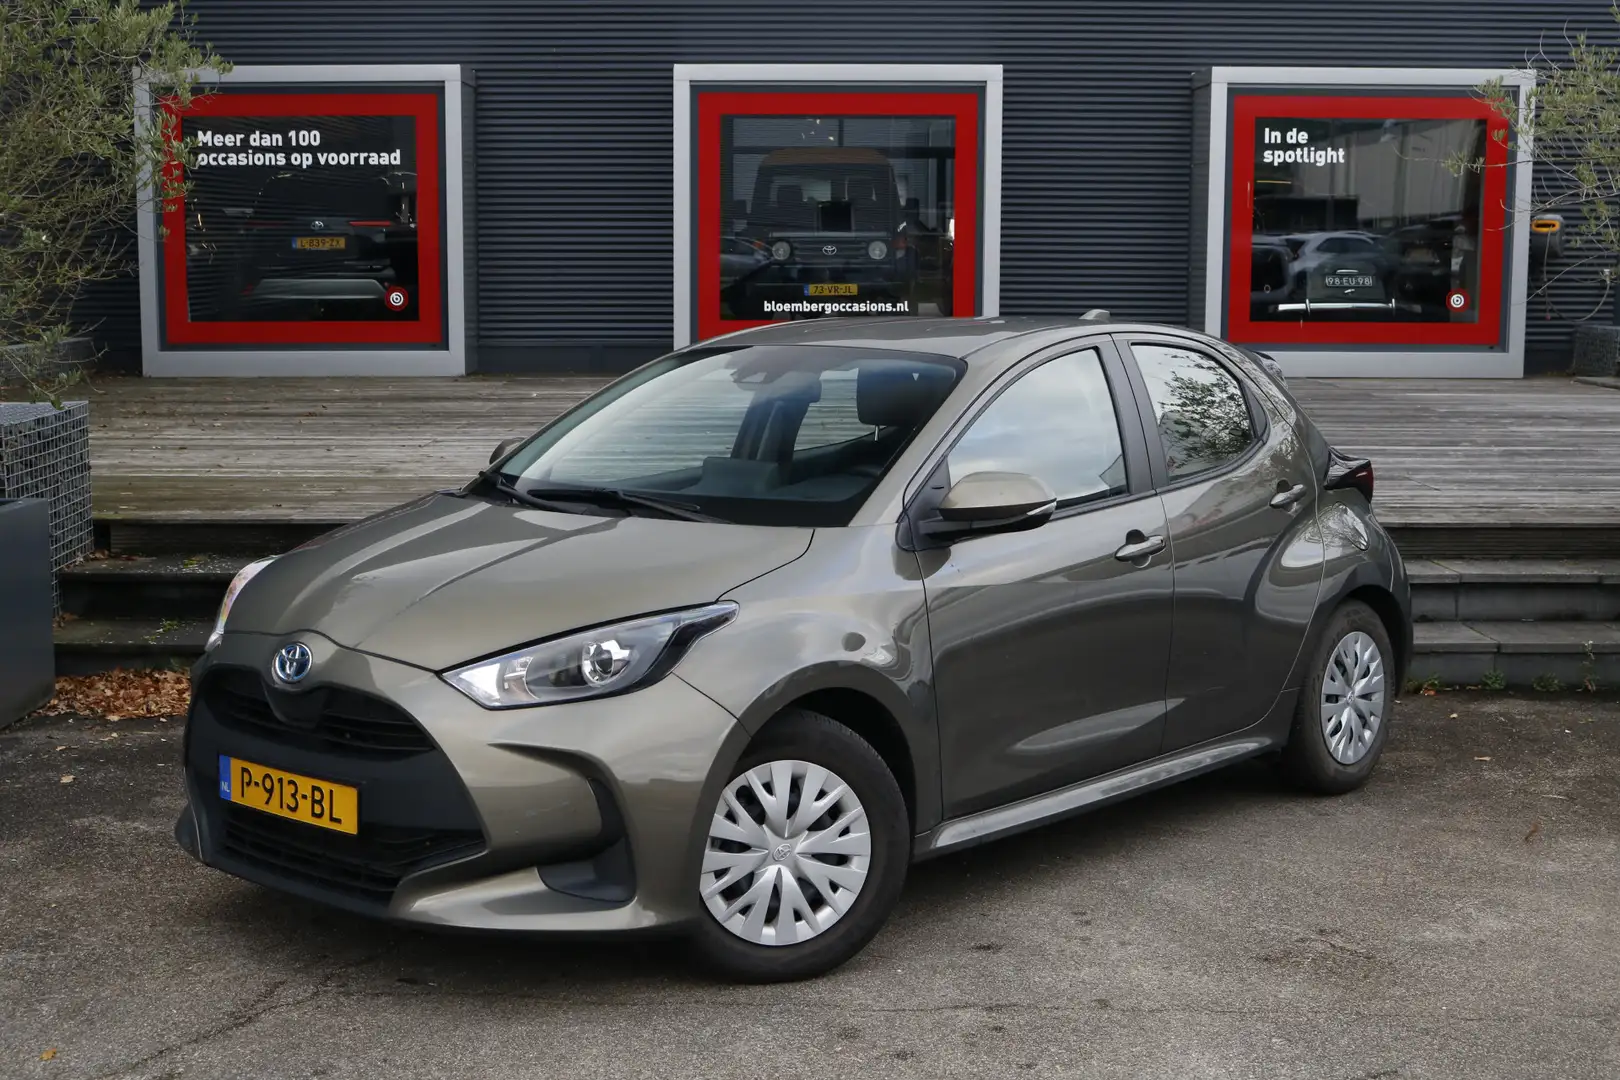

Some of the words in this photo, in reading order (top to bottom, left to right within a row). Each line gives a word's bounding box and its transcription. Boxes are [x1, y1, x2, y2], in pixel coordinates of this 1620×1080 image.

[197, 130, 245, 146] Meer
[249, 130, 283, 147] dan
[288, 130, 321, 147] 100
[1264, 128, 1282, 143] In
[1286, 128, 1309, 144] de
[197, 149, 286, 165] occasions
[291, 152, 313, 168] op
[317, 149, 401, 166] voorraad
[1263, 148, 1345, 166] spotlight
[764, 300, 909, 314] bloembergoccasions.nl
[240, 766, 342, 824] P-913-BL
